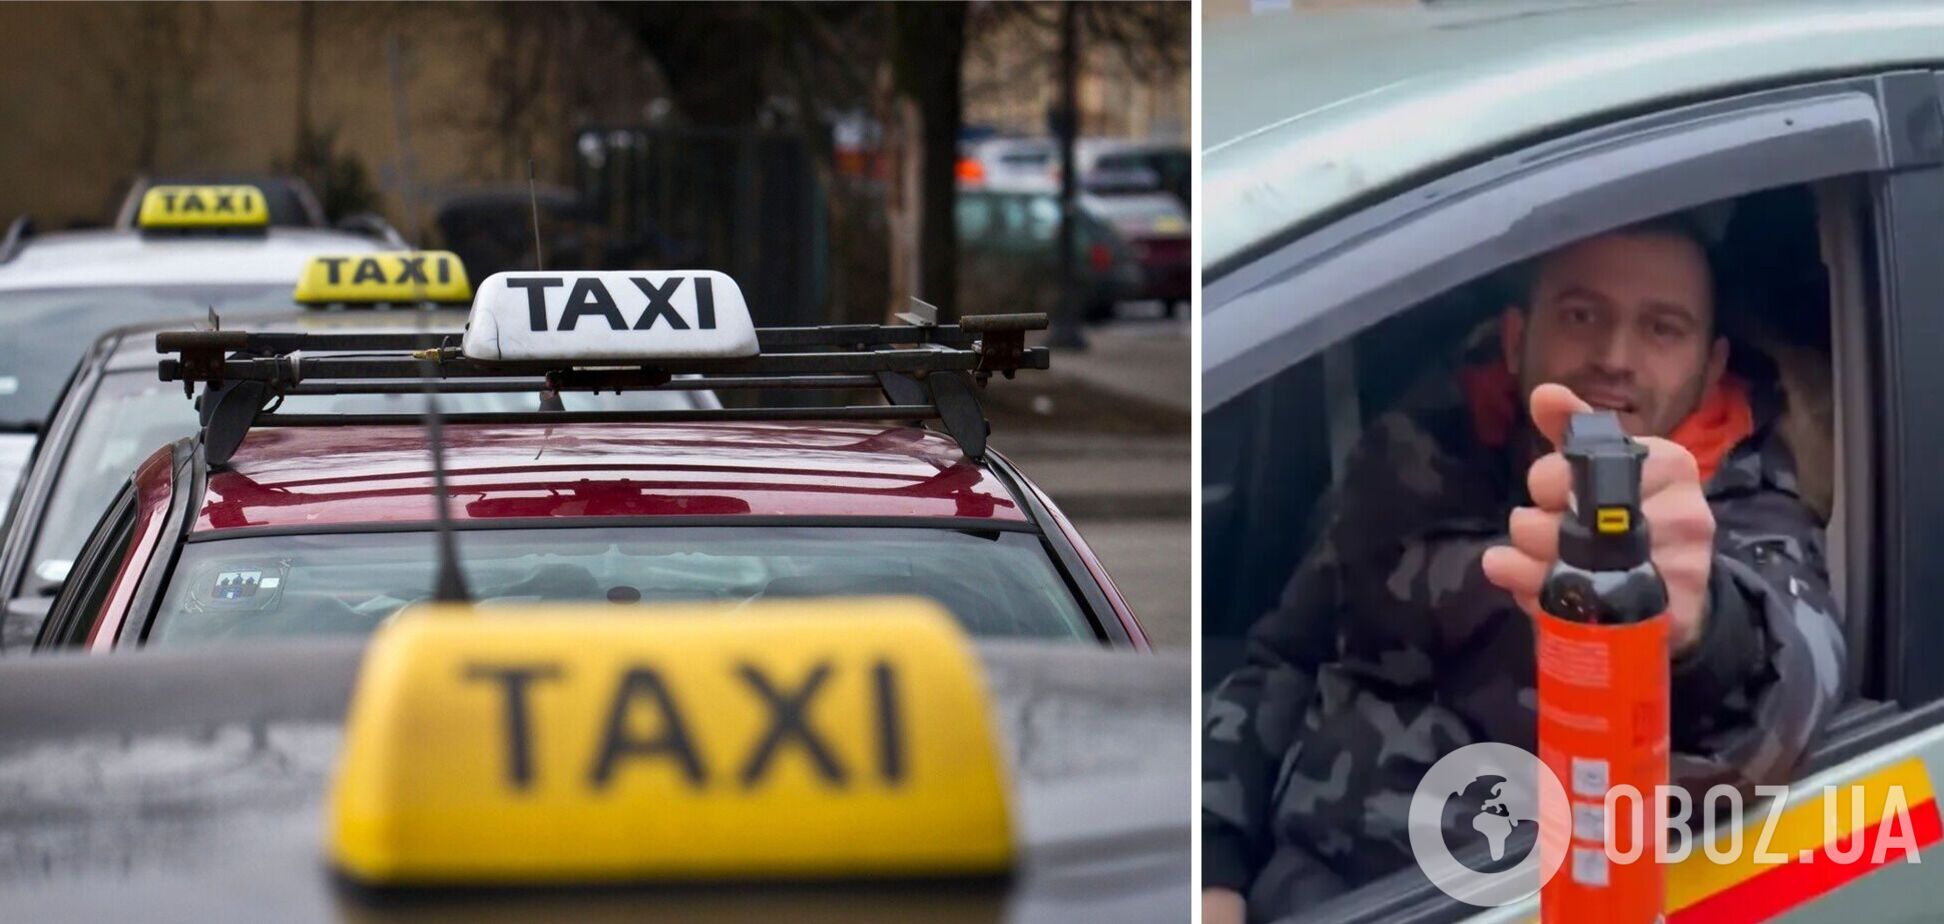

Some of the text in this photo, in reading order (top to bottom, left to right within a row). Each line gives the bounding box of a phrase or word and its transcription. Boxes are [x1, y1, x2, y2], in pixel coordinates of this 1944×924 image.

[159, 192, 254, 214] TAXI
[317, 256, 451, 285] TAXI
[506, 276, 717, 331] TAXI
[463, 661, 910, 790] TAXI
